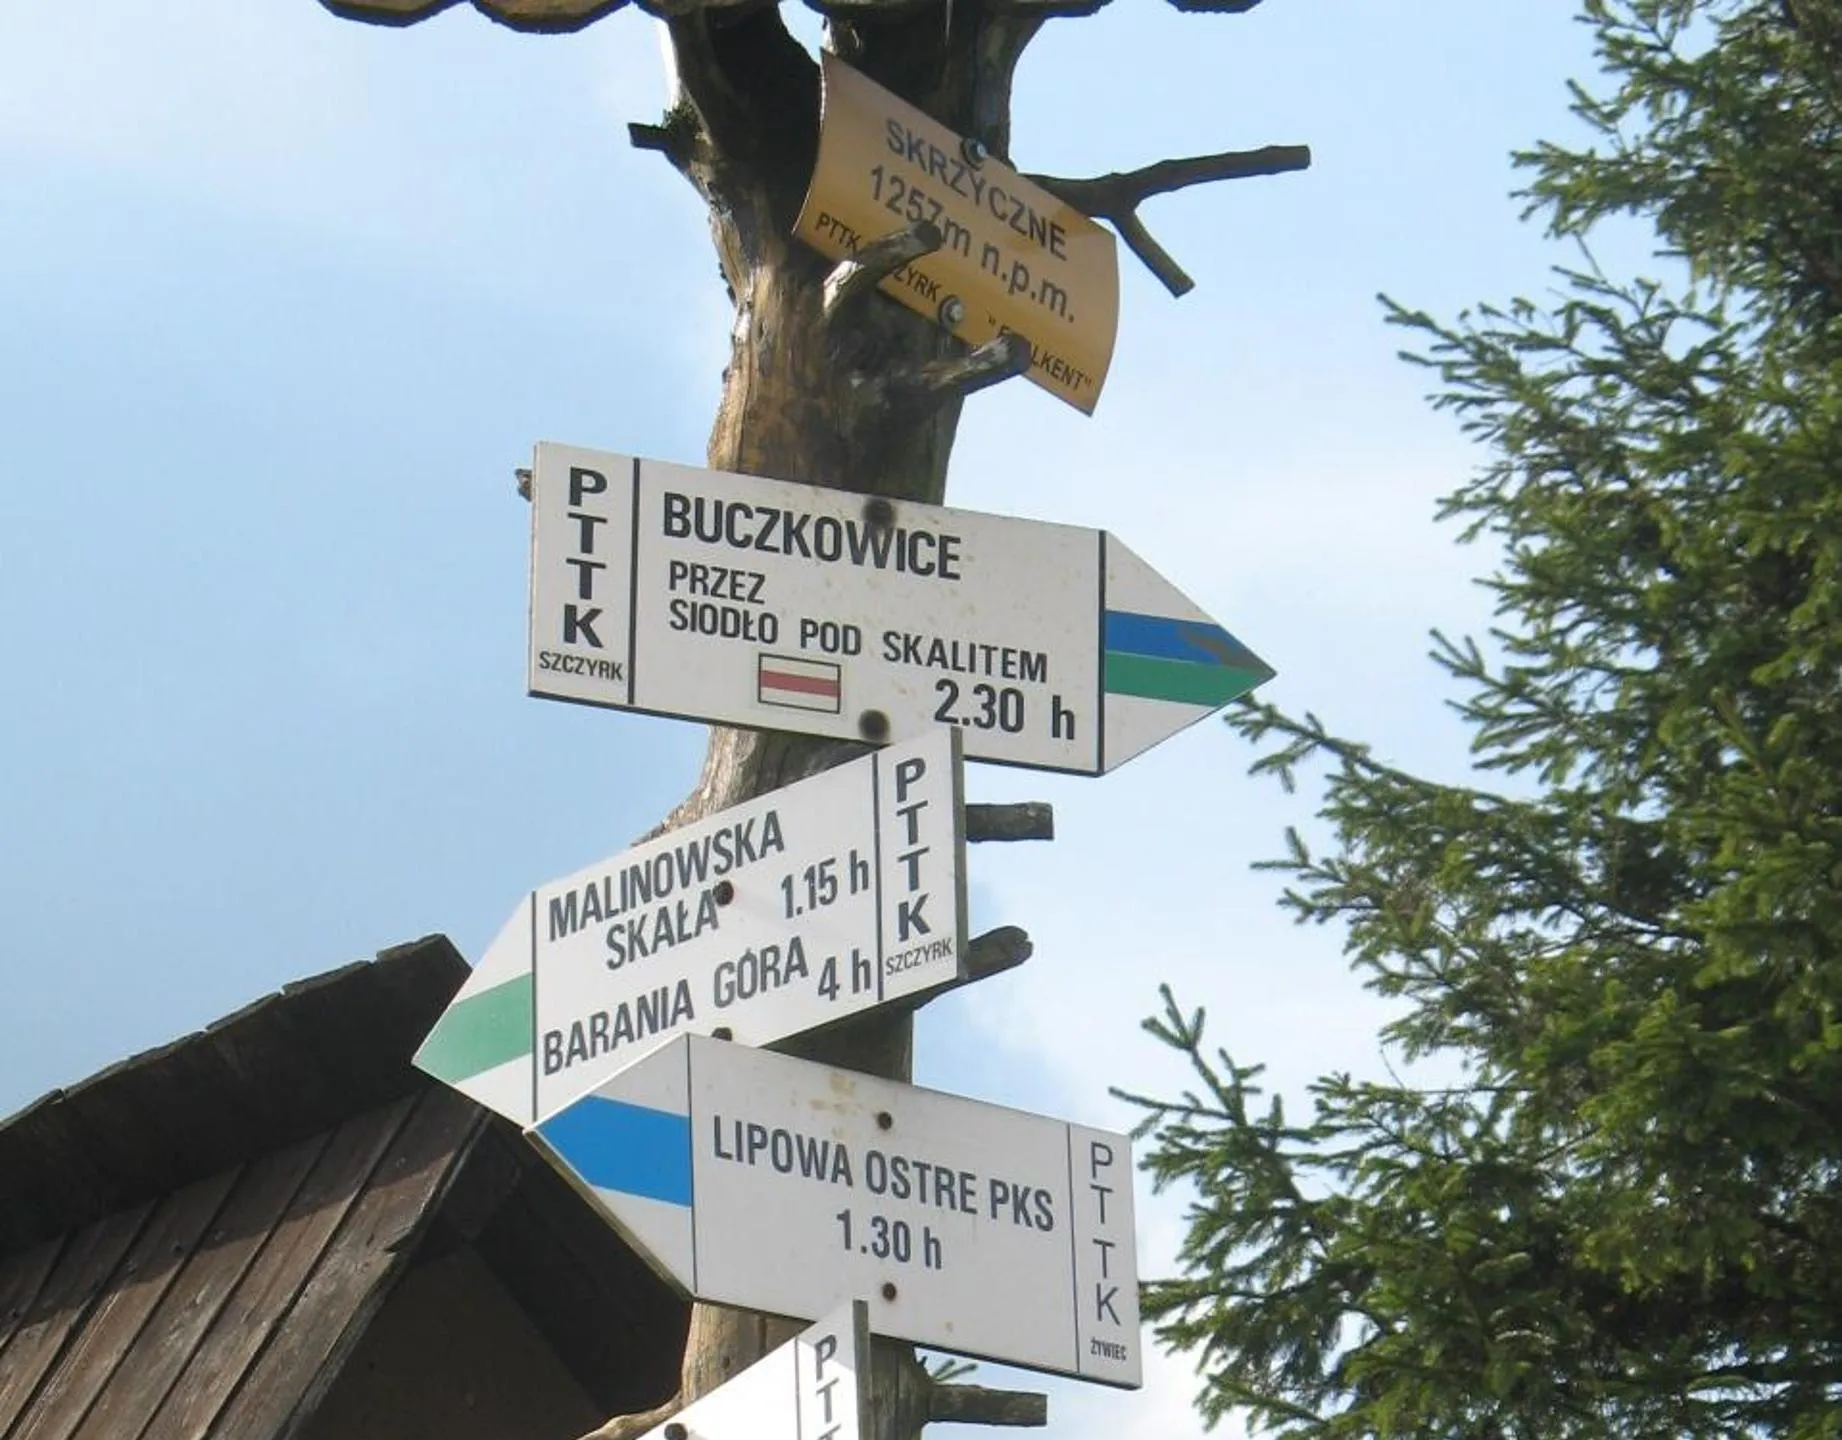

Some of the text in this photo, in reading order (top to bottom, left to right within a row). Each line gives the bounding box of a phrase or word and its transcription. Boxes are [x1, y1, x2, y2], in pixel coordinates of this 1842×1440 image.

[815, 211, 862, 252] PTTK
[886, 118, 1068, 262] SKRZYCZNE
[563, 466, 608, 649] PTTK
[662, 491, 962, 581] BUCZKOWICE
[669, 561, 766, 605] PRZEZ
[539, 650, 624, 682] SZCZYRK
[669, 600, 1048, 684] SIODŁO POD SKALITEM
[933, 678, 1076, 740] 2.30 h
[548, 811, 785, 943] MALINOWSKA
[896, 757, 932, 942] PTTK
[606, 848, 870, 971] SKAŁA 1.15 h
[885, 937, 954, 977] SZCZYRK
[543, 936, 871, 1077] BARANIA GÓRA 4 h
[712, 1115, 1055, 1233] LIPOWA OSTRE PKS
[836, 1208, 942, 1270] 1.30 h
[1091, 1142, 1121, 1326] PTTK
